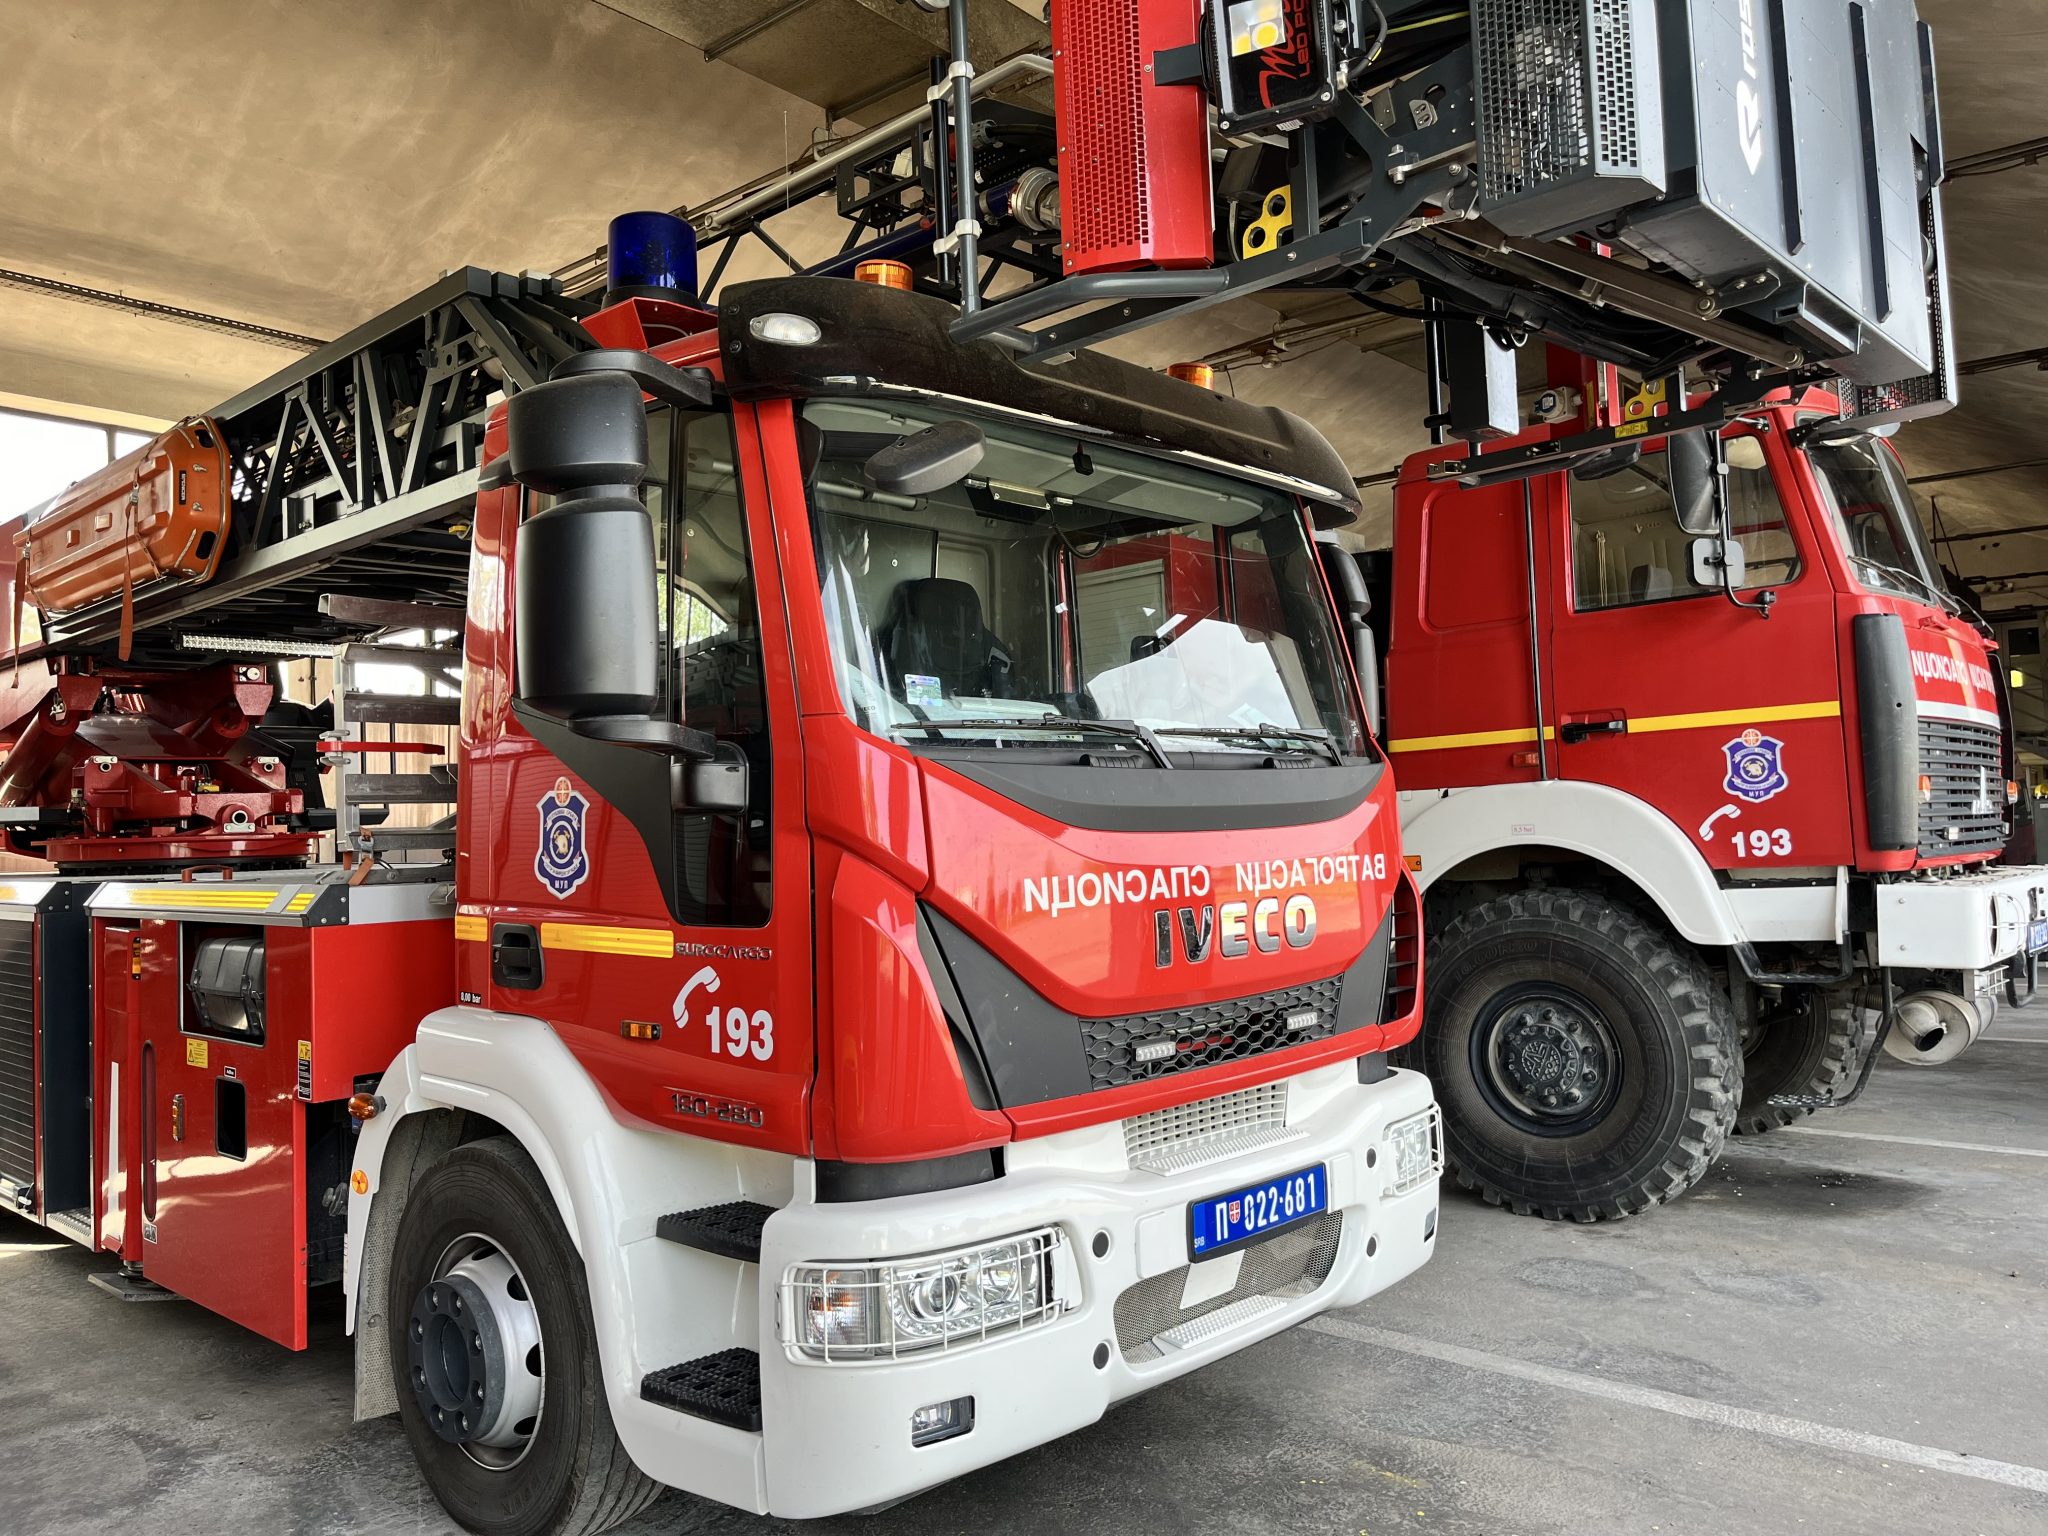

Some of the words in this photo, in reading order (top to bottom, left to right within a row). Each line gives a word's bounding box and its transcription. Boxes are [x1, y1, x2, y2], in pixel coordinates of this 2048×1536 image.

[1731, 828, 1792, 858] 193
[1154, 894, 1318, 968] IVECO
[676, 942, 773, 960] EUROCARGO
[705, 1006, 774, 1061] 193
[1194, 1236, 1205, 1248] SRB
